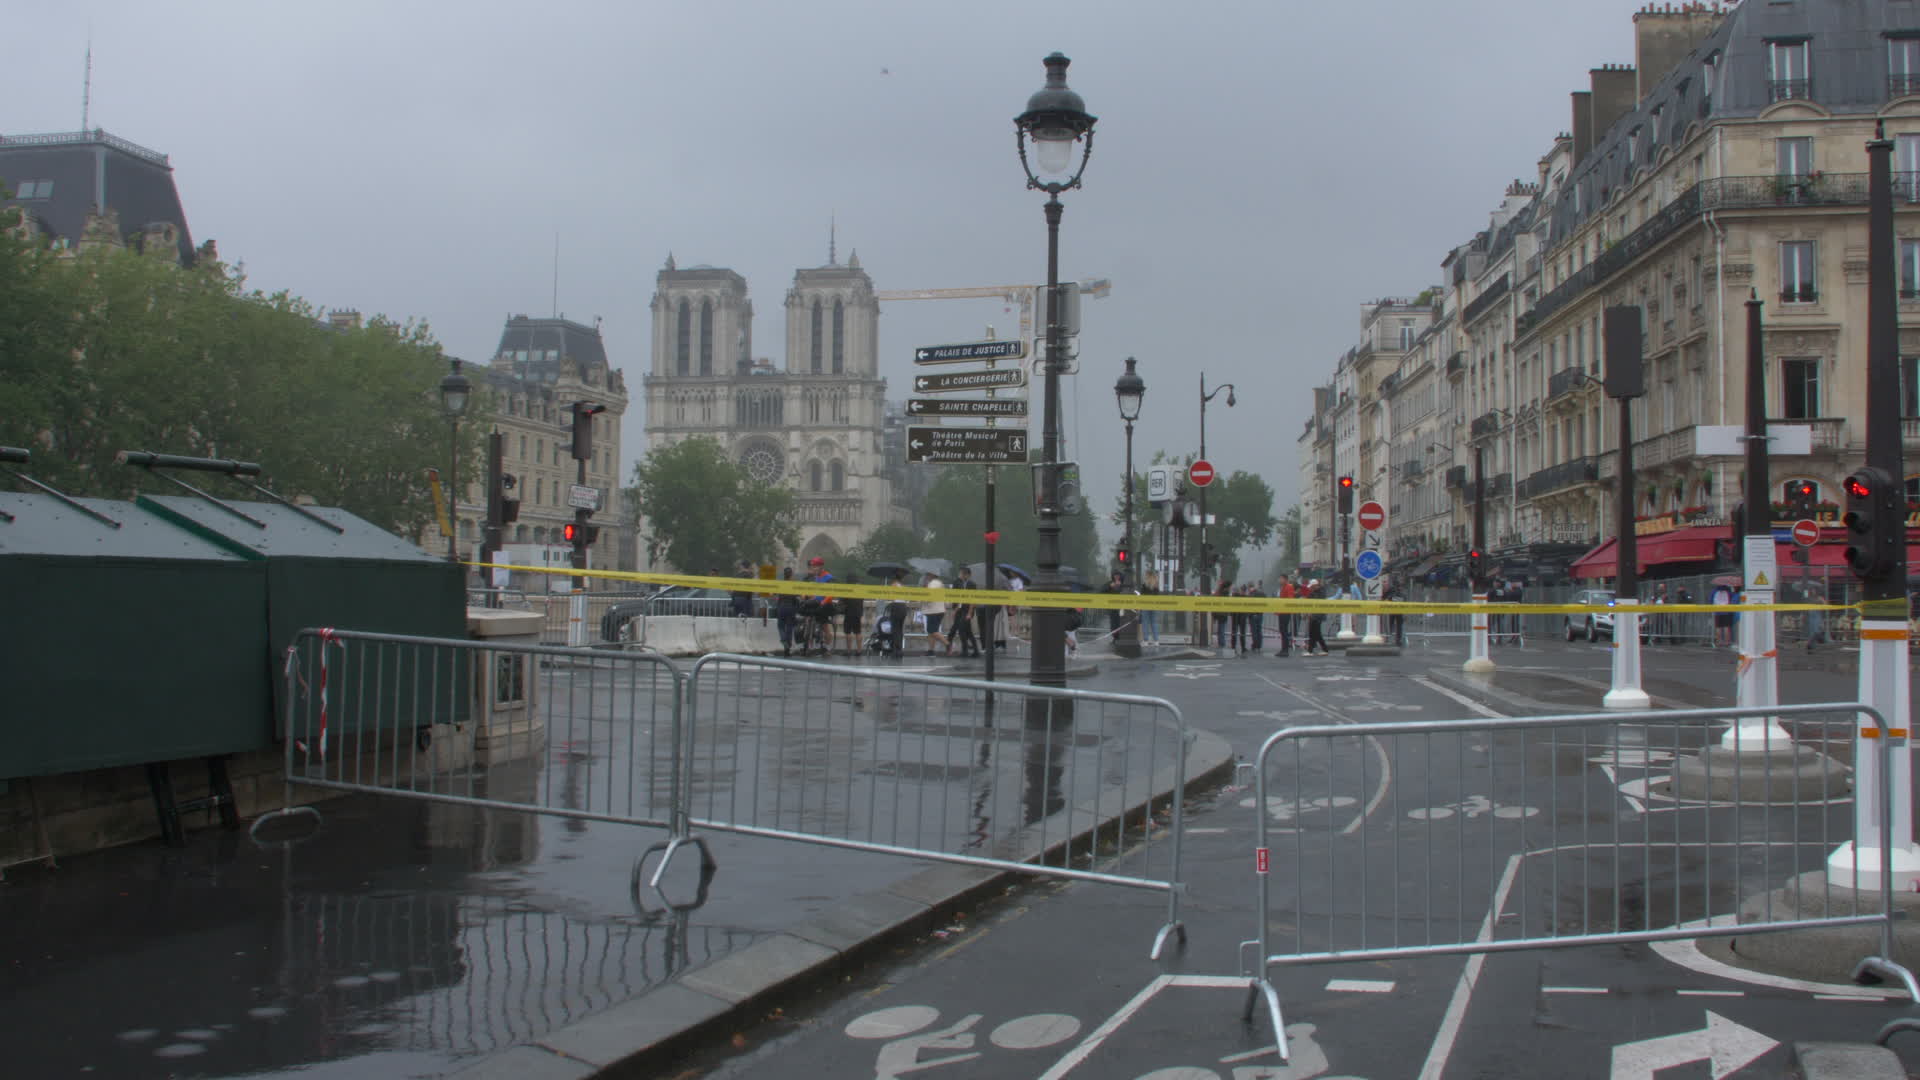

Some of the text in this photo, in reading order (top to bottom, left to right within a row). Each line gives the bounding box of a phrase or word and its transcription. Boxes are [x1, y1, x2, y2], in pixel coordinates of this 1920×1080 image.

[934, 345, 1006, 358] PALAIS DE JUSTICE
[941, 373, 1009, 386] LA CONCIERGERIE
[939, 403, 1013, 411] SAINTE CHAPELLE
[932, 431, 998, 440] Théâtre Musical
[932, 450, 1008, 459] Théâtre de la Ville
